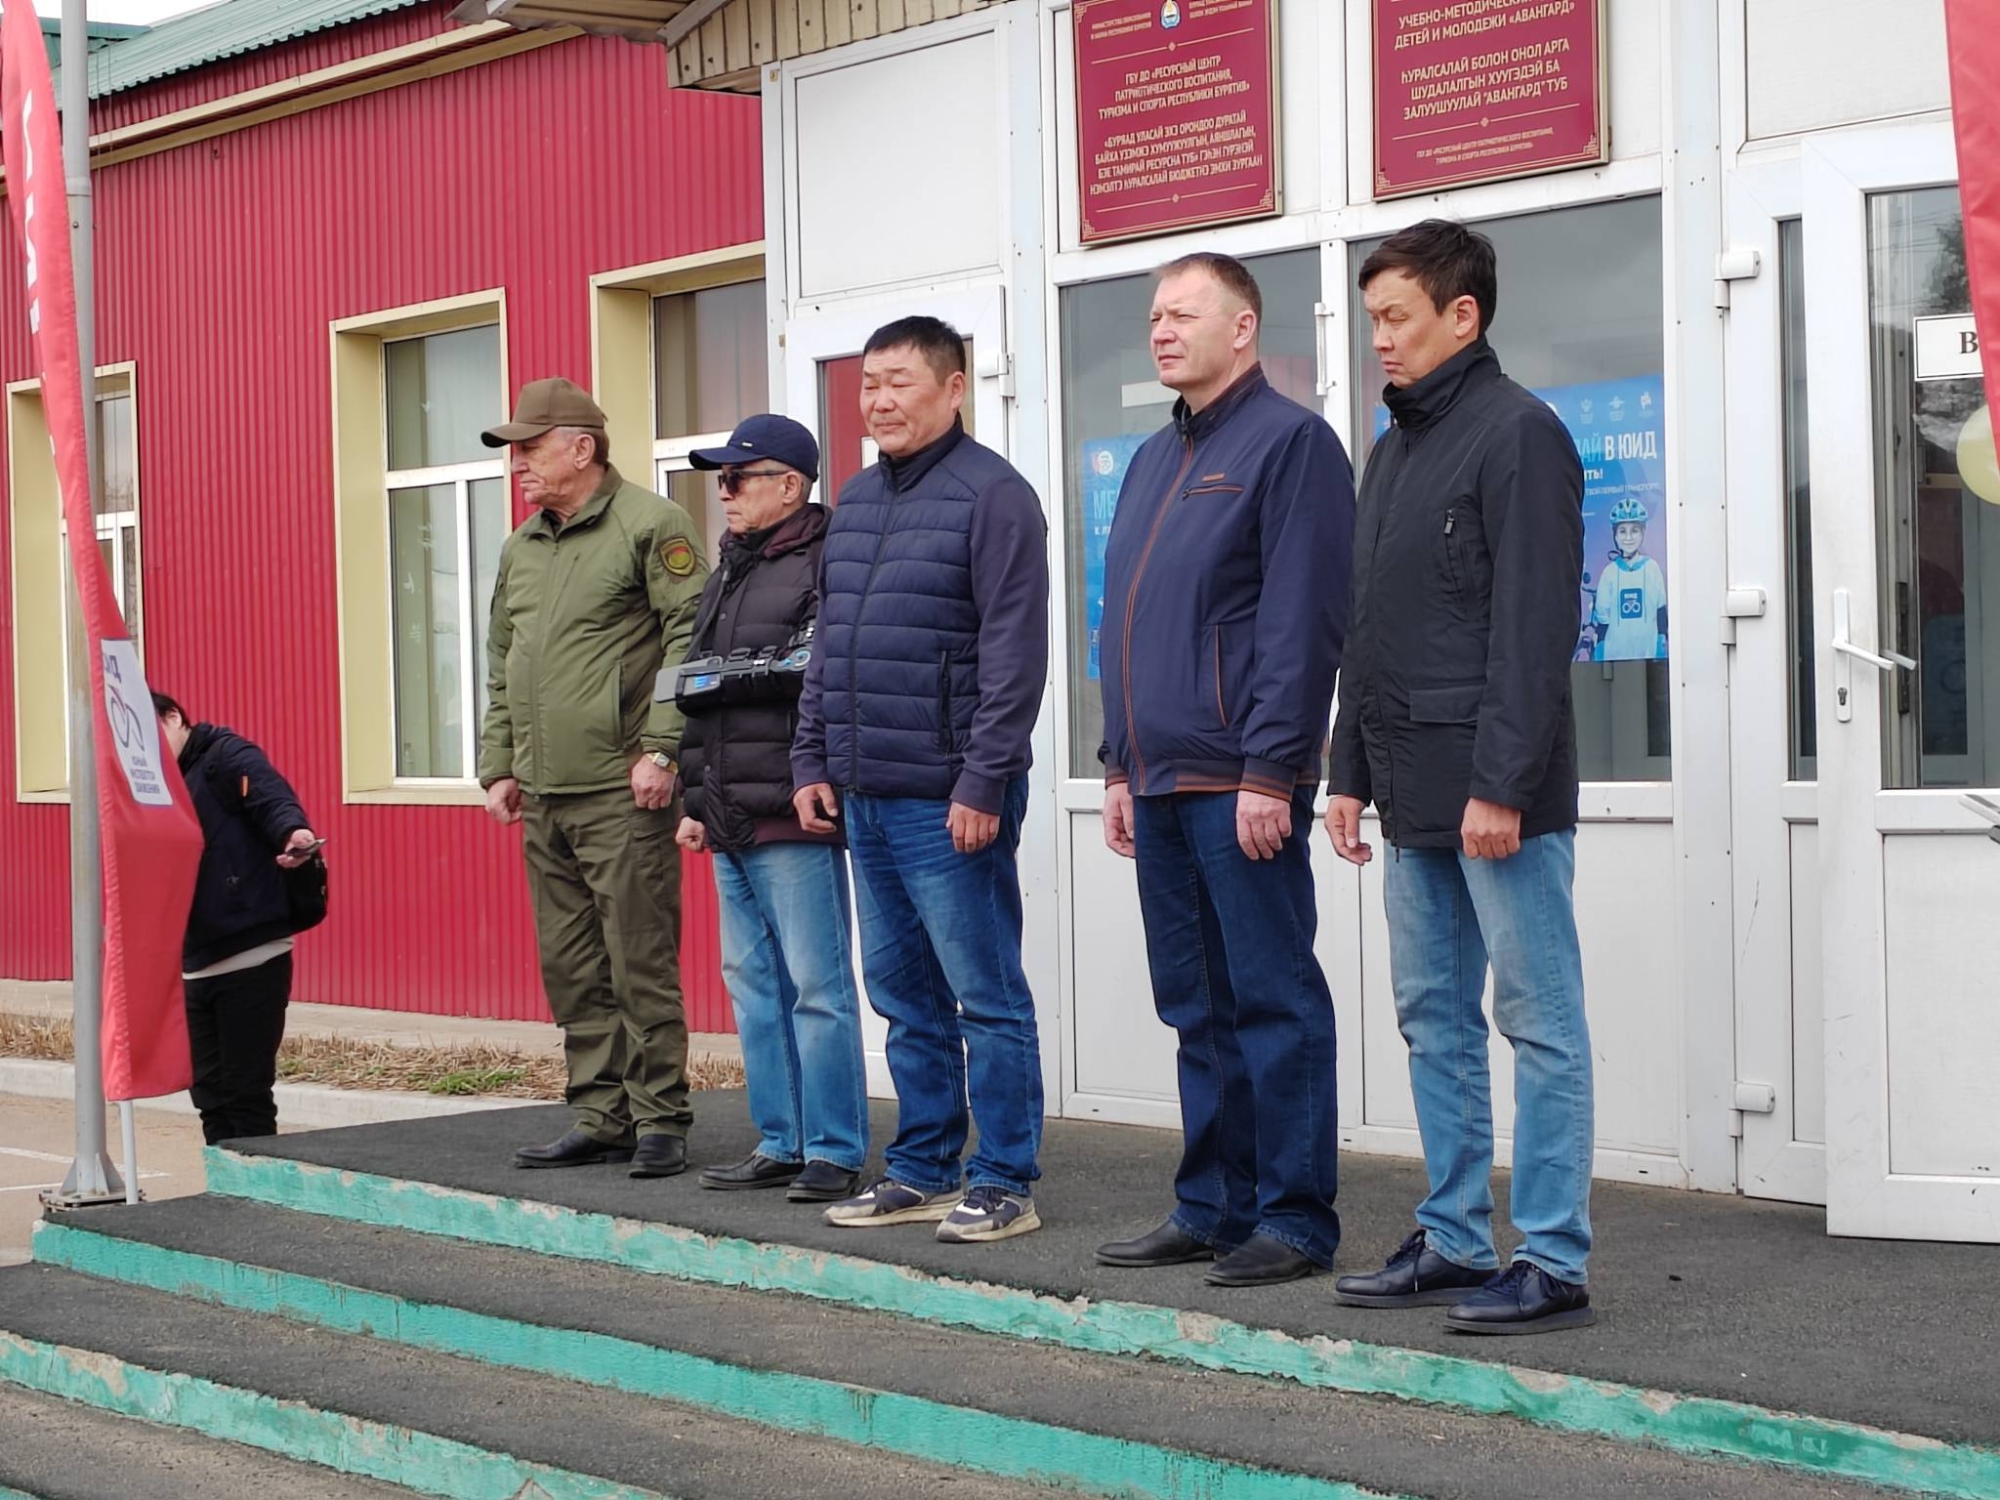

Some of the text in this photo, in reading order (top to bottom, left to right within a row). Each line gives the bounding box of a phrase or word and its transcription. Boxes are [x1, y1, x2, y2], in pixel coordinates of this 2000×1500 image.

[1394, 27, 1429, 51] ДЕТЕЙ
[1432, 27, 1440, 41] И
[1443, 13, 1506, 39] МОЛОДЕЖИ
[1471, 50, 1509, 71] БОЛОН
[1511, 43, 1542, 62] ОНОЛ
[1543, 37, 1570, 56] АРГА
[1411, 74, 1486, 100] ШУДАЛАЛГЫН
[1545, 58, 1560, 74] БА
[1604, 435, 1615, 461] В
[1618, 430, 1657, 460] ЮИД
